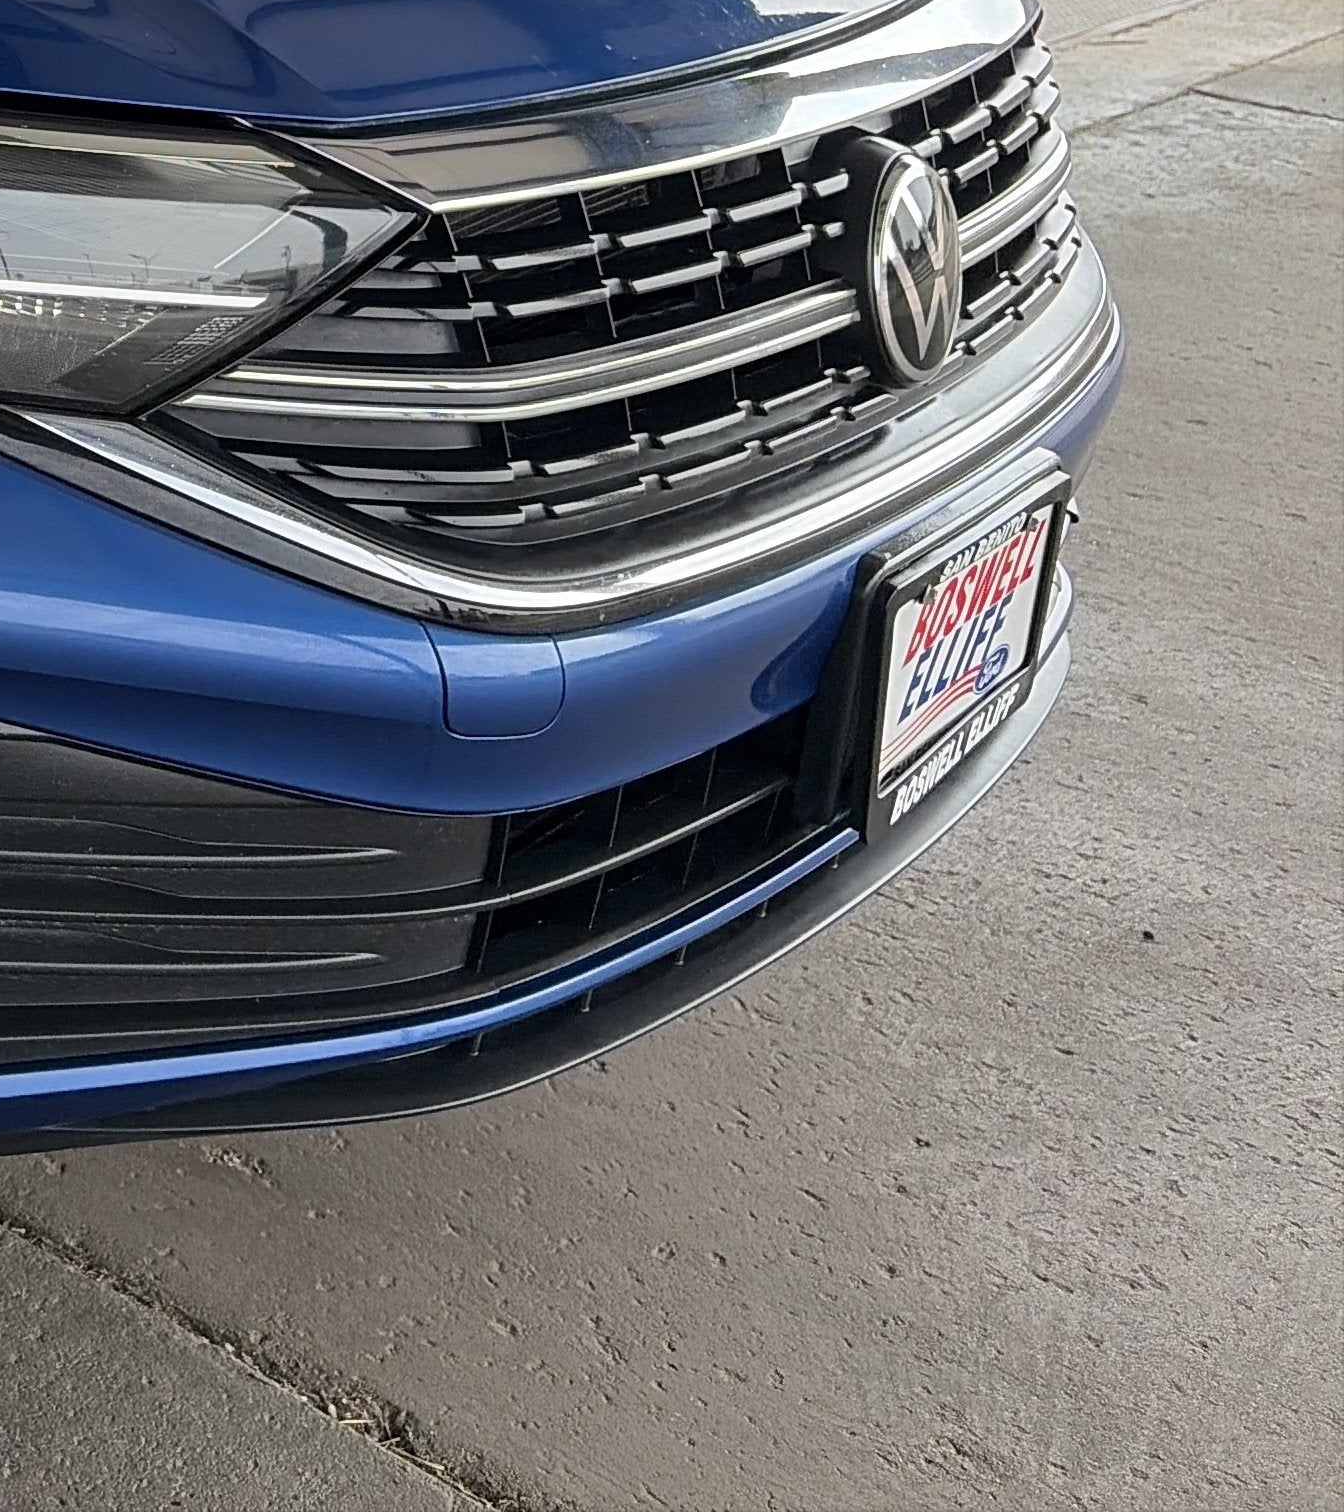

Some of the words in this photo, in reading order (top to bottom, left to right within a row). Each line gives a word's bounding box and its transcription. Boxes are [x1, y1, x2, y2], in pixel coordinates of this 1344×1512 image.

[903, 518, 1047, 668] BOSWELL
[939, 545, 976, 584] SAN
[974, 511, 1027, 562] BENITO
[897, 592, 1014, 726] ELLIFF
[890, 731, 965, 826] BOSWELL
[964, 682, 1020, 756] ELLIFF
